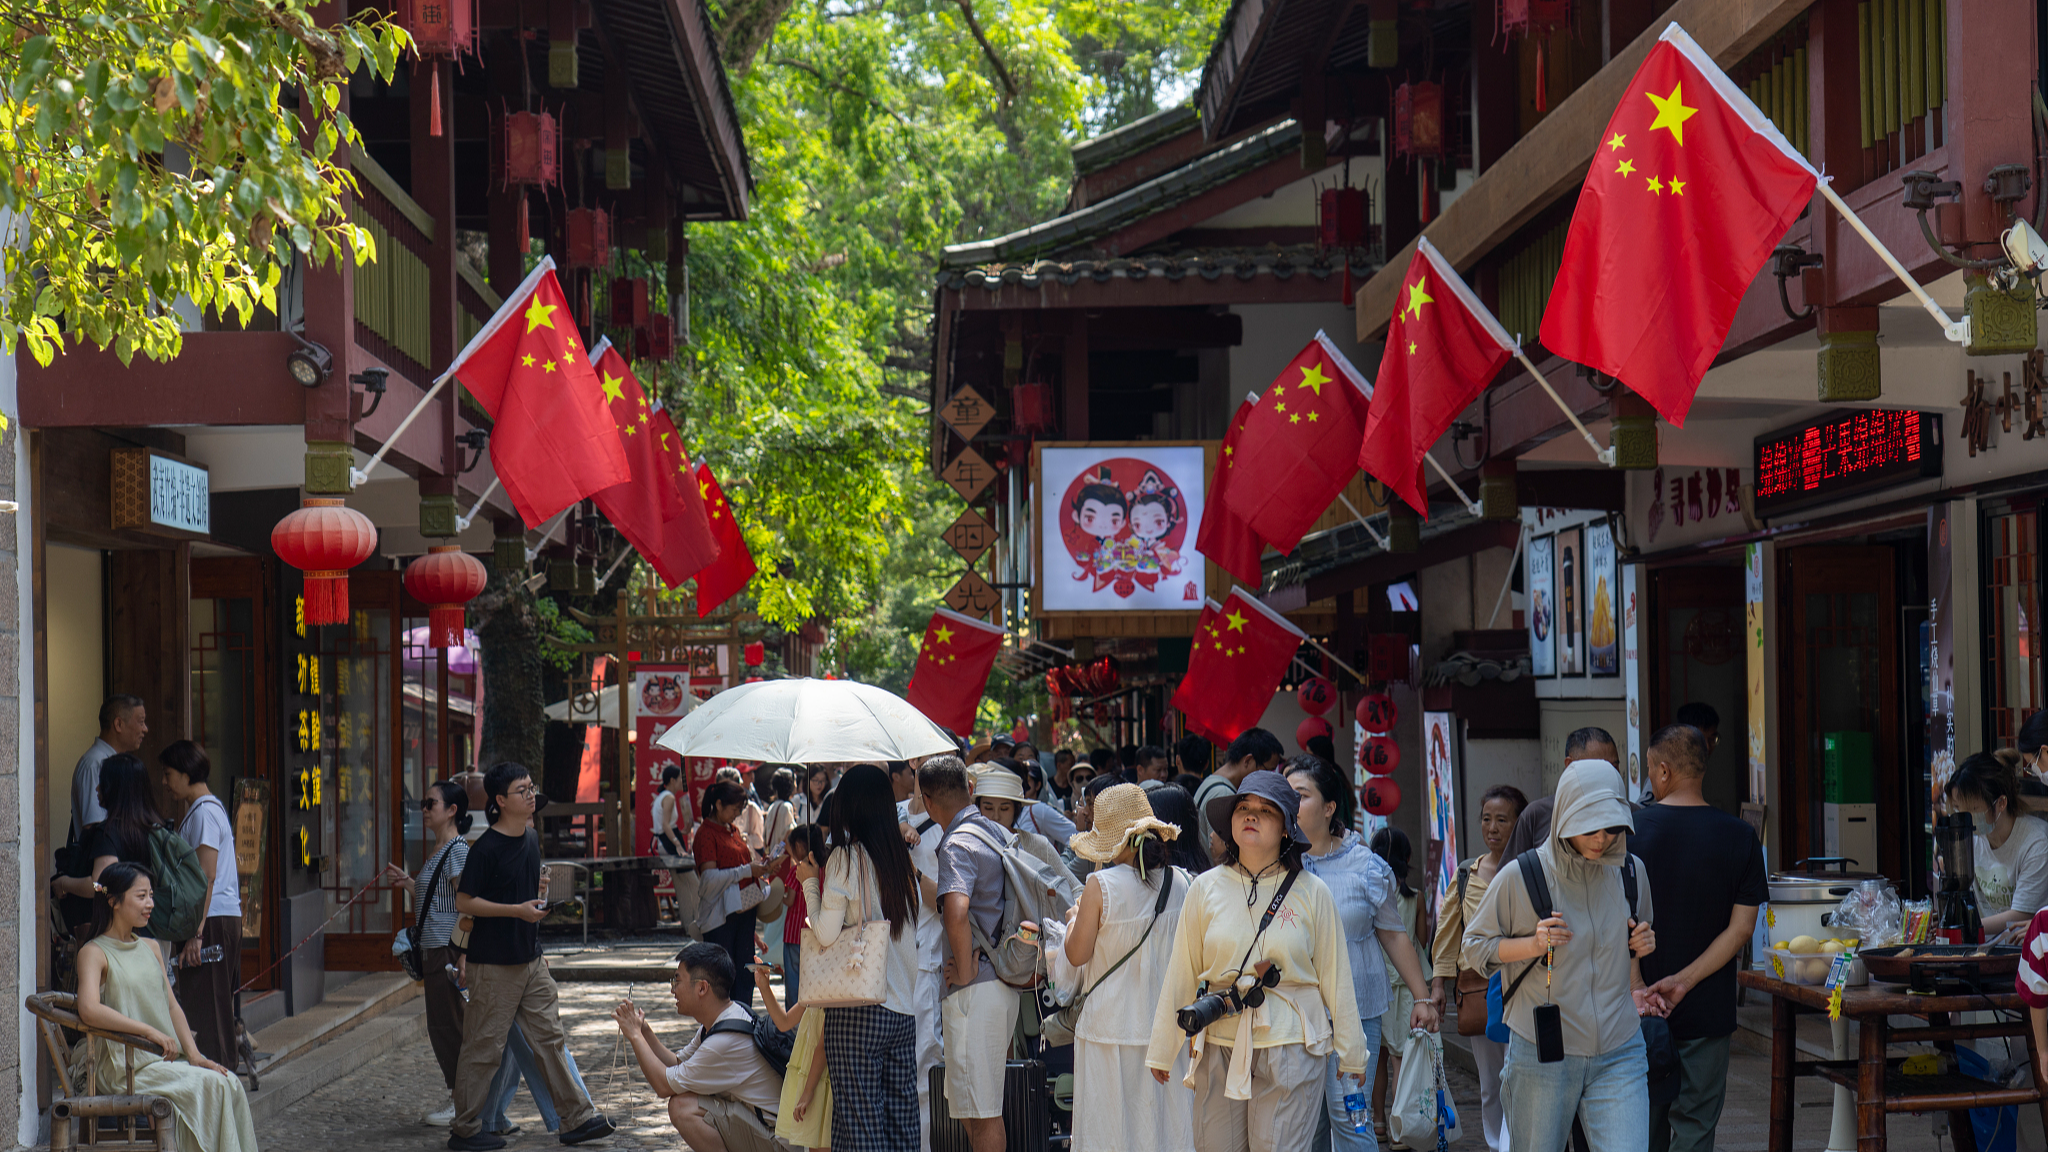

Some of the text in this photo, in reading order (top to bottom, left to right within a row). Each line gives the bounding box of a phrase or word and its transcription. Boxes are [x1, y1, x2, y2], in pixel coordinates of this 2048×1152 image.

[951, 396, 990, 613] 童年时光
[1362, 741, 1388, 766] 福
